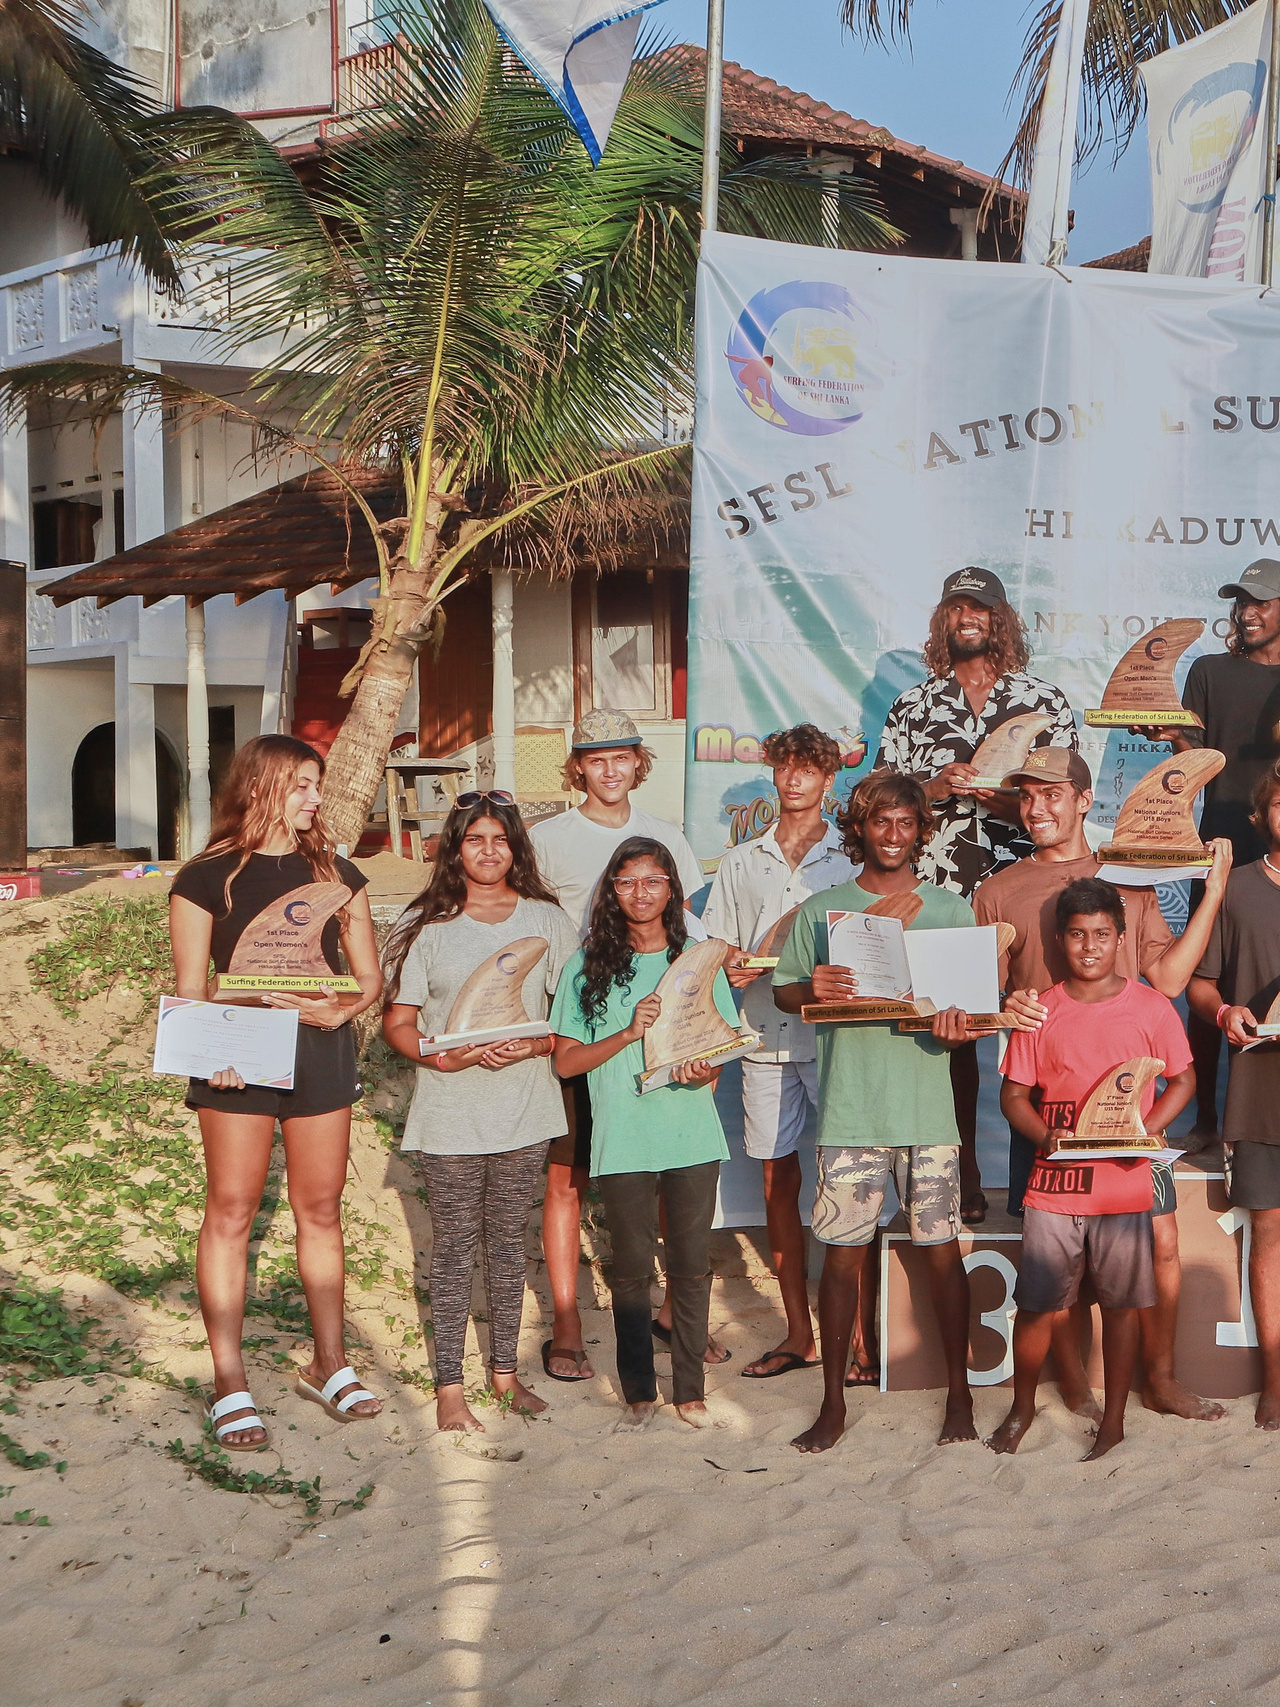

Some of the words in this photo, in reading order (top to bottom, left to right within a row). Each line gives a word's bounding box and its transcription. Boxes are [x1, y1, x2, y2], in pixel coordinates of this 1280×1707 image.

[818, 379, 865, 393] FEDERATION
[825, 393, 851, 406] LANKA
[716, 460, 855, 541] SFSL
[1103, 852, 1128, 860] Surfing
[1129, 852, 1167, 860] Federation
[226, 978, 256, 987] Surfing
[257, 979, 302, 987] Federation
[303, 979, 312, 987] of
[808, 1009, 831, 1018] Surfing
[832, 1007, 867, 1016] Federation
[888, 1005, 907, 1013] Lanka
[1029, 1168, 1086, 1192] NTROL
[962, 1249, 1019, 1387] 3
